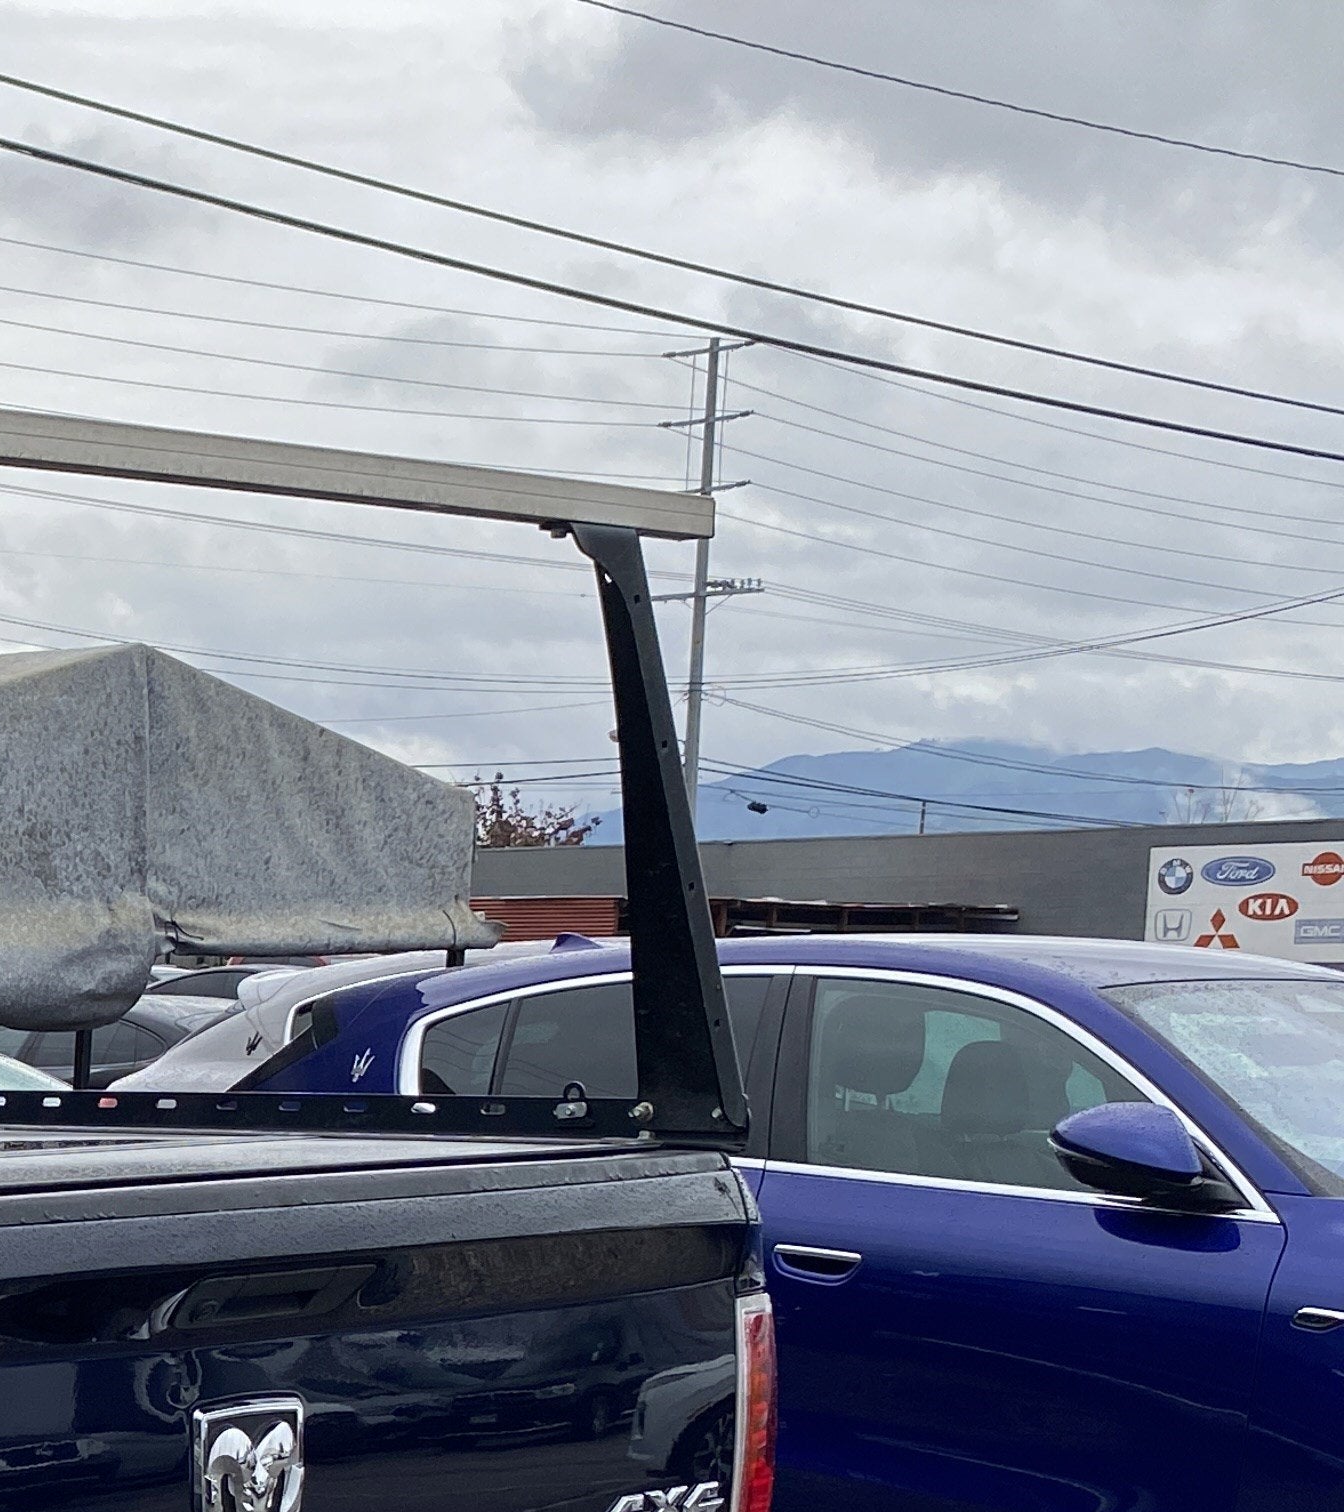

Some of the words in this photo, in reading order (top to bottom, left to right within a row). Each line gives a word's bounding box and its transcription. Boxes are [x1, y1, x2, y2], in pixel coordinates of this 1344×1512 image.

[1217, 862, 1257, 880] Ford
[1248, 899, 1290, 916] KIA
[1300, 925, 1341, 937] GMC
